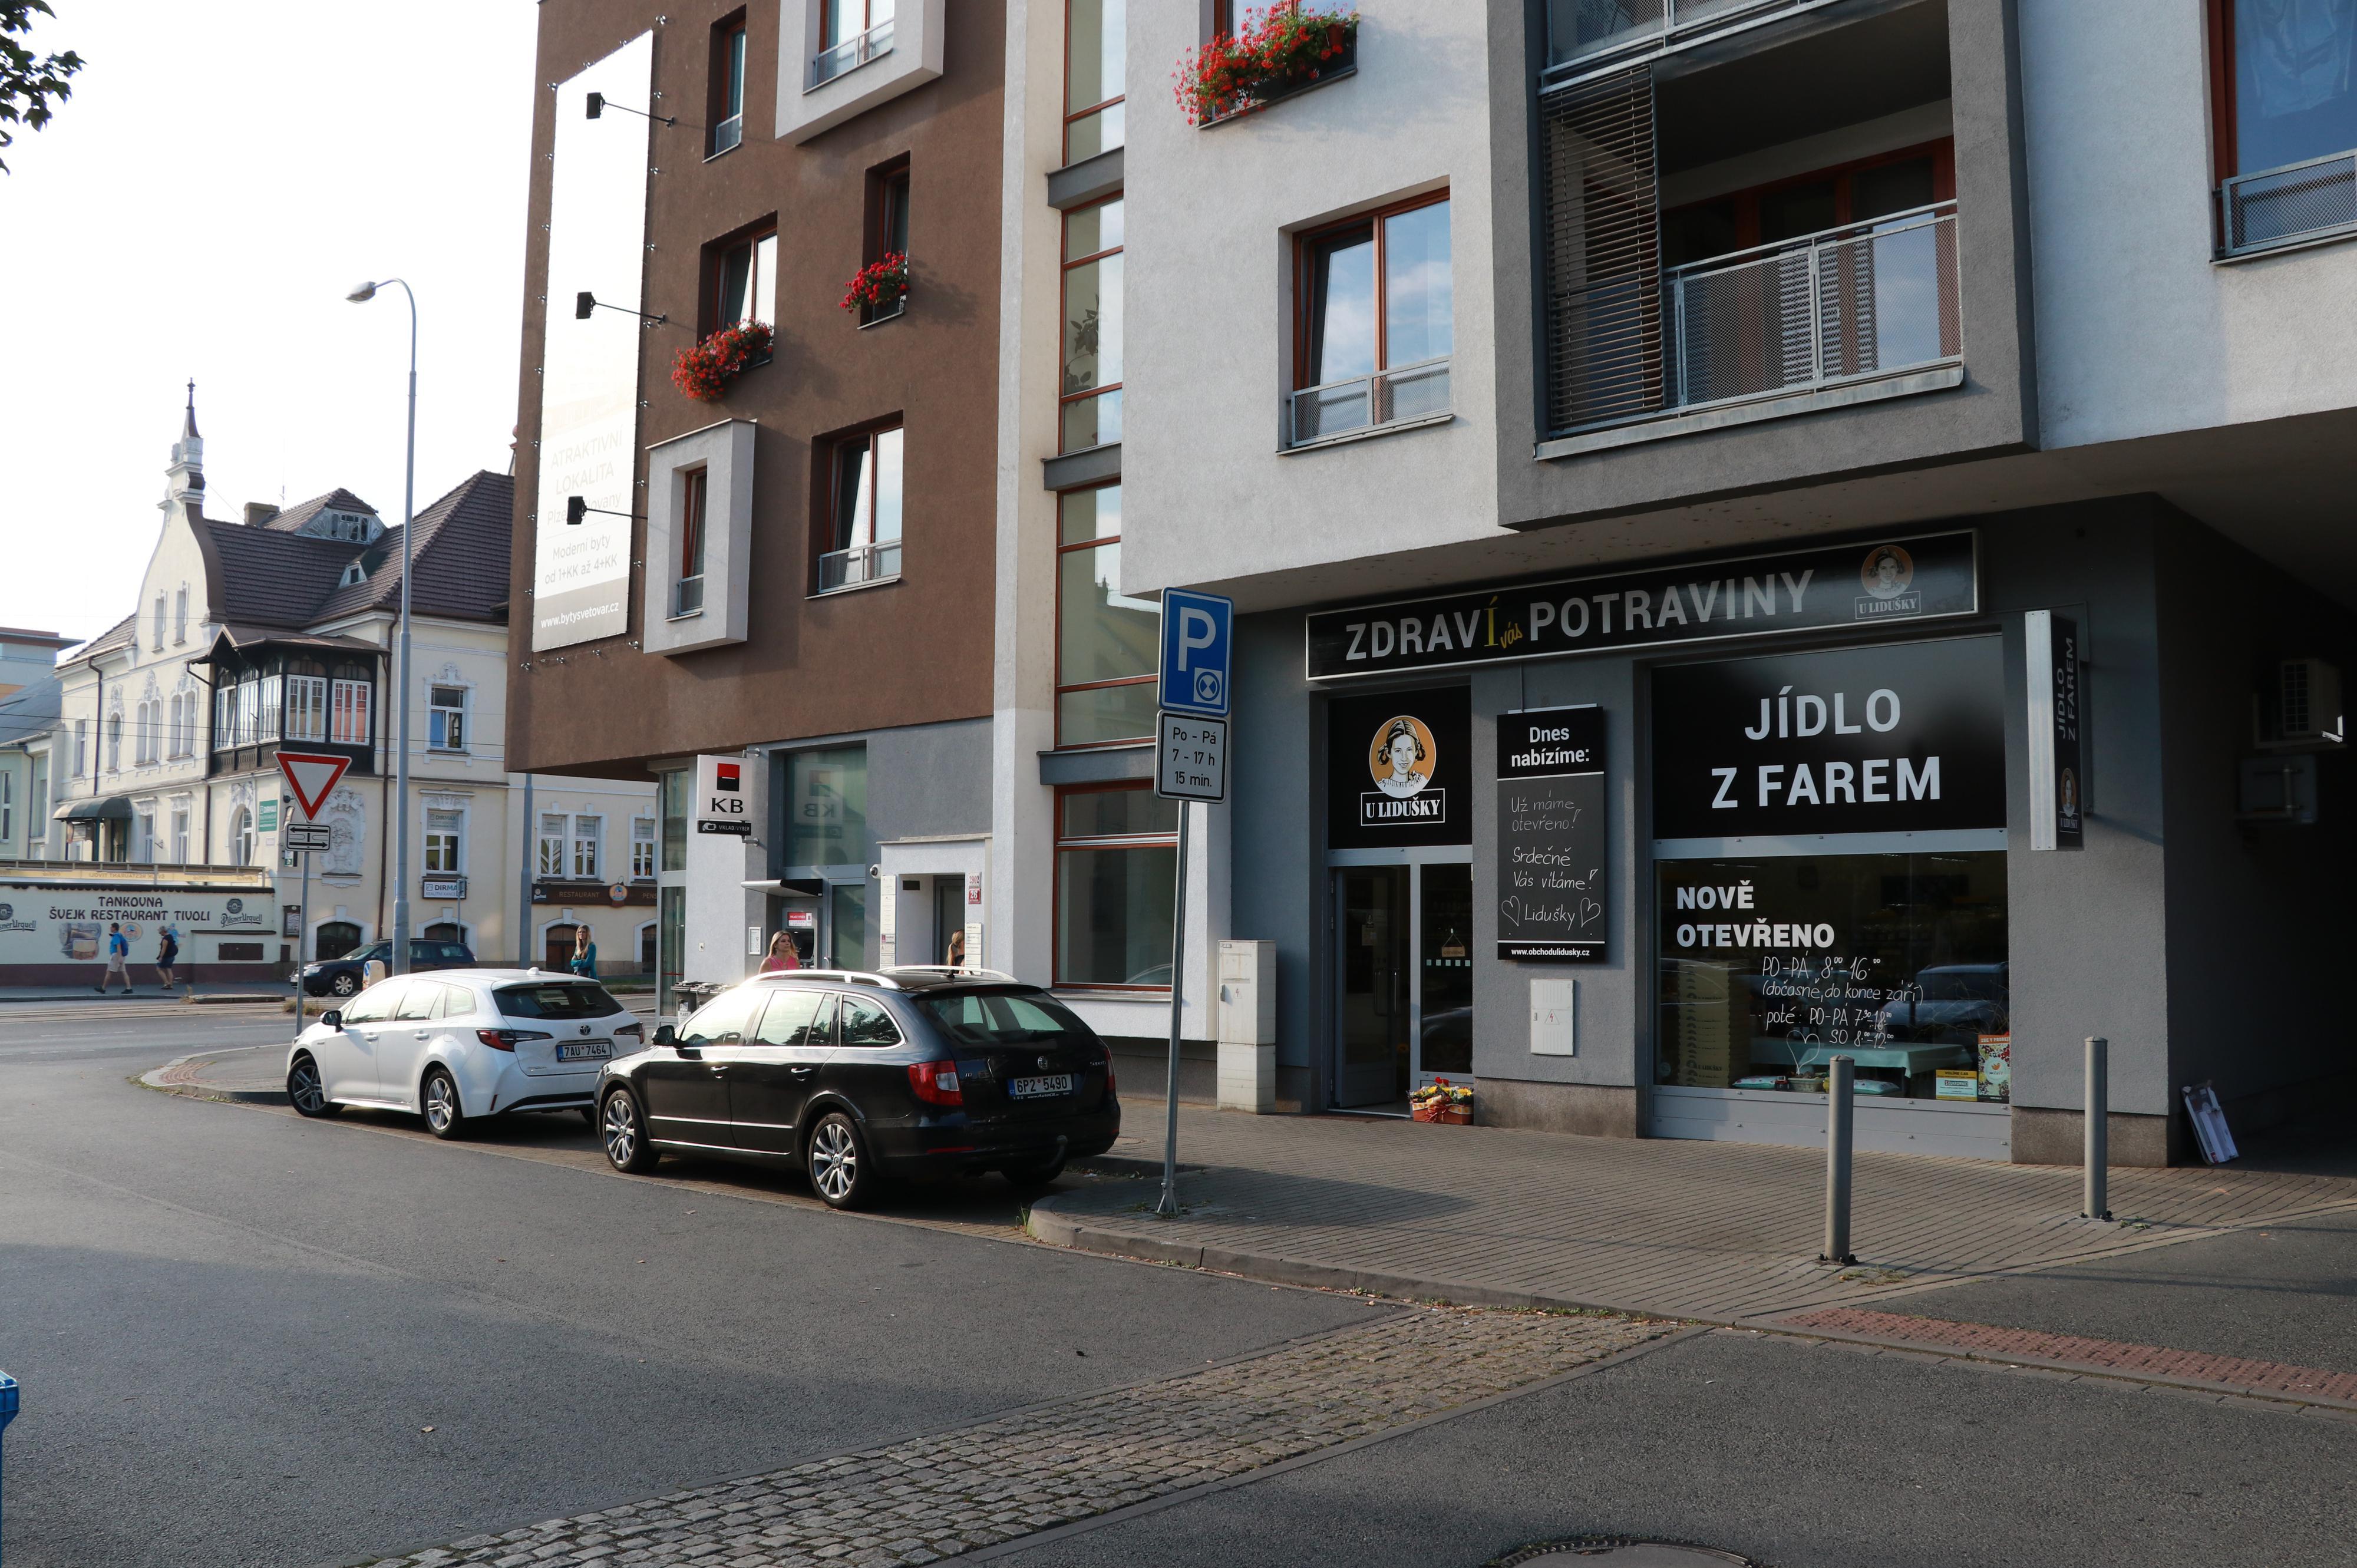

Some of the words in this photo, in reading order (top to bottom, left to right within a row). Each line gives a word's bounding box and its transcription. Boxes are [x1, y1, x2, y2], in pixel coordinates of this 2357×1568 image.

[551, 424, 622, 469] ATRAKTIVNÍ
[556, 461, 614, 495] LOKALITA
[547, 507, 567, 526] Plze
[553, 537, 589, 560] Moderní
[590, 534, 610, 551] byty
[544, 570, 556, 585] od
[559, 563, 579, 580] 1+KK
[581, 560, 590, 575] až
[593, 553, 618, 570] 4+KK
[540, 602, 619, 628] www.bytysvetovar.cz
[1346, 595, 1498, 661] ZDRAVÍ
[1500, 621, 1523, 649] vás
[1530, 569, 1814, 642] POTRAVINY
[1858, 603, 1867, 614] U
[1869, 597, 1917, 613] LIDUŠKY
[1178, 606, 1216, 672] P
[2065, 637, 2075, 720] FAREM
[1744, 685, 1900, 740] JÍDLO
[2056, 668, 2065, 739] JÍDLO
[1173, 727, 1187, 741] Po
[1202, 731, 1216, 745] Pá
[1530, 726, 1570, 743] Dnes
[2068, 727, 2075, 741] Z
[1173, 749, 1179, 761] 7
[1194, 751, 1204, 764] 17
[1209, 753, 1215, 766] h
[1511, 747, 1589, 767] nabízíme:
[1175, 771, 1185, 784] 15
[1190, 774, 1211, 787] min.
[1711, 767, 1738, 808] Z
[1758, 756, 1940, 807] FAREM
[711, 797, 744, 814] KB
[1366, 803, 1376, 818] U
[1378, 796, 1441, 818] LIDUŠKY
[1511, 797, 1528, 813] Už
[1533, 790, 1575, 811] máme
[1512, 808, 1582, 831] otevřeno!
[1513, 845, 1572, 867] Srdečně
[1513, 870, 1534, 887] Vás
[1541, 869, 1598, 890] vítáme!
[98, 896, 163, 908] TANKOVNA
[970, 890, 978, 899] 26
[1677, 880, 1754, 910] NOVĚ
[49, 906, 85, 920] ŠVEJK
[91, 910, 168, 921] RESTAURANT
[174, 910, 210, 922] TIVOLI
[1524, 903, 1575, 930] Lidušky
[1676, 917, 1835, 948] OTEVŘENO
[1511, 948, 1590, 956] www.obchodulidusky.cz
[1845, 982, 1880, 1000] konce
[1829, 1029, 1848, 1044] SO
[565, 1046, 580, 1057] 7AU
[586, 1045, 606, 1055] 7464
[1017, 1080, 1036, 1093] 6P2
[1044, 1076, 1067, 1091] 5490
